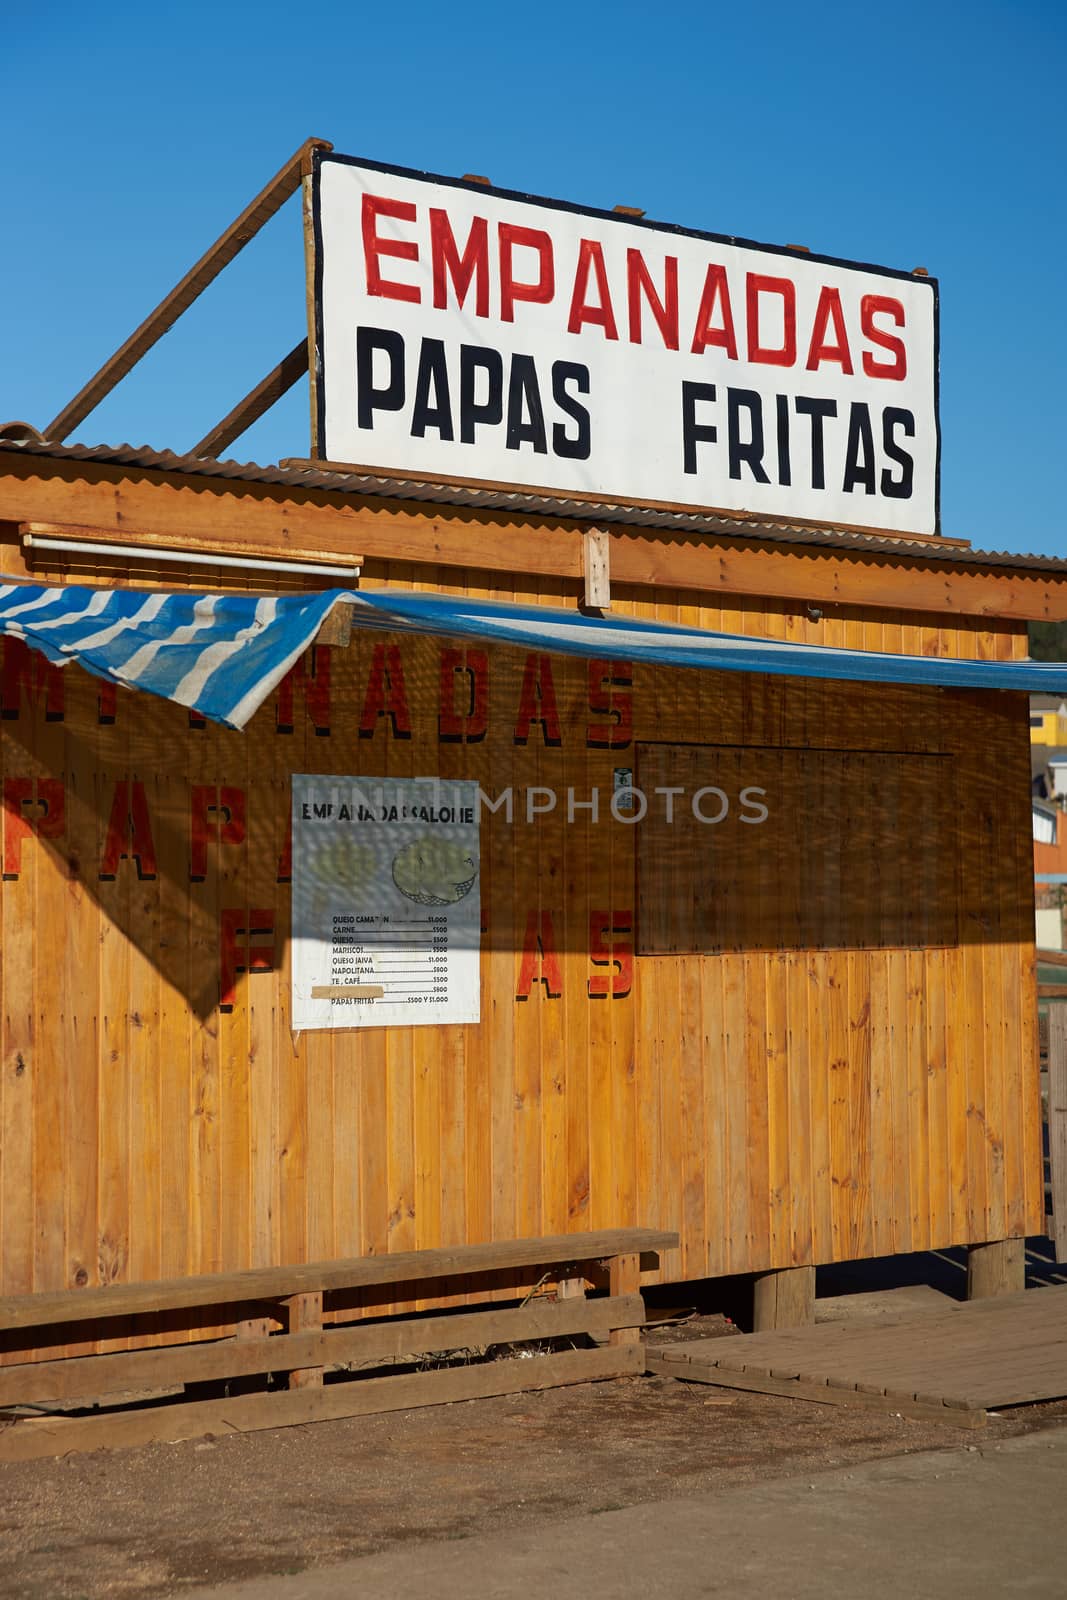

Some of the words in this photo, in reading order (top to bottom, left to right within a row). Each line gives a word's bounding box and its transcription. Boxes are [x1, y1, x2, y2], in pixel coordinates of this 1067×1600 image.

[361, 192, 907, 382] EMPANADAS
[356, 326, 592, 461] PAPAS
[681, 380, 916, 500] FRITAS
[332, 915, 355, 924] QUESO
[332, 936, 354, 944] QUESO
[332, 946, 364, 954] MARISCOS
[332, 957, 354, 965] QUESO
[355, 956, 373, 964] JAIVA
